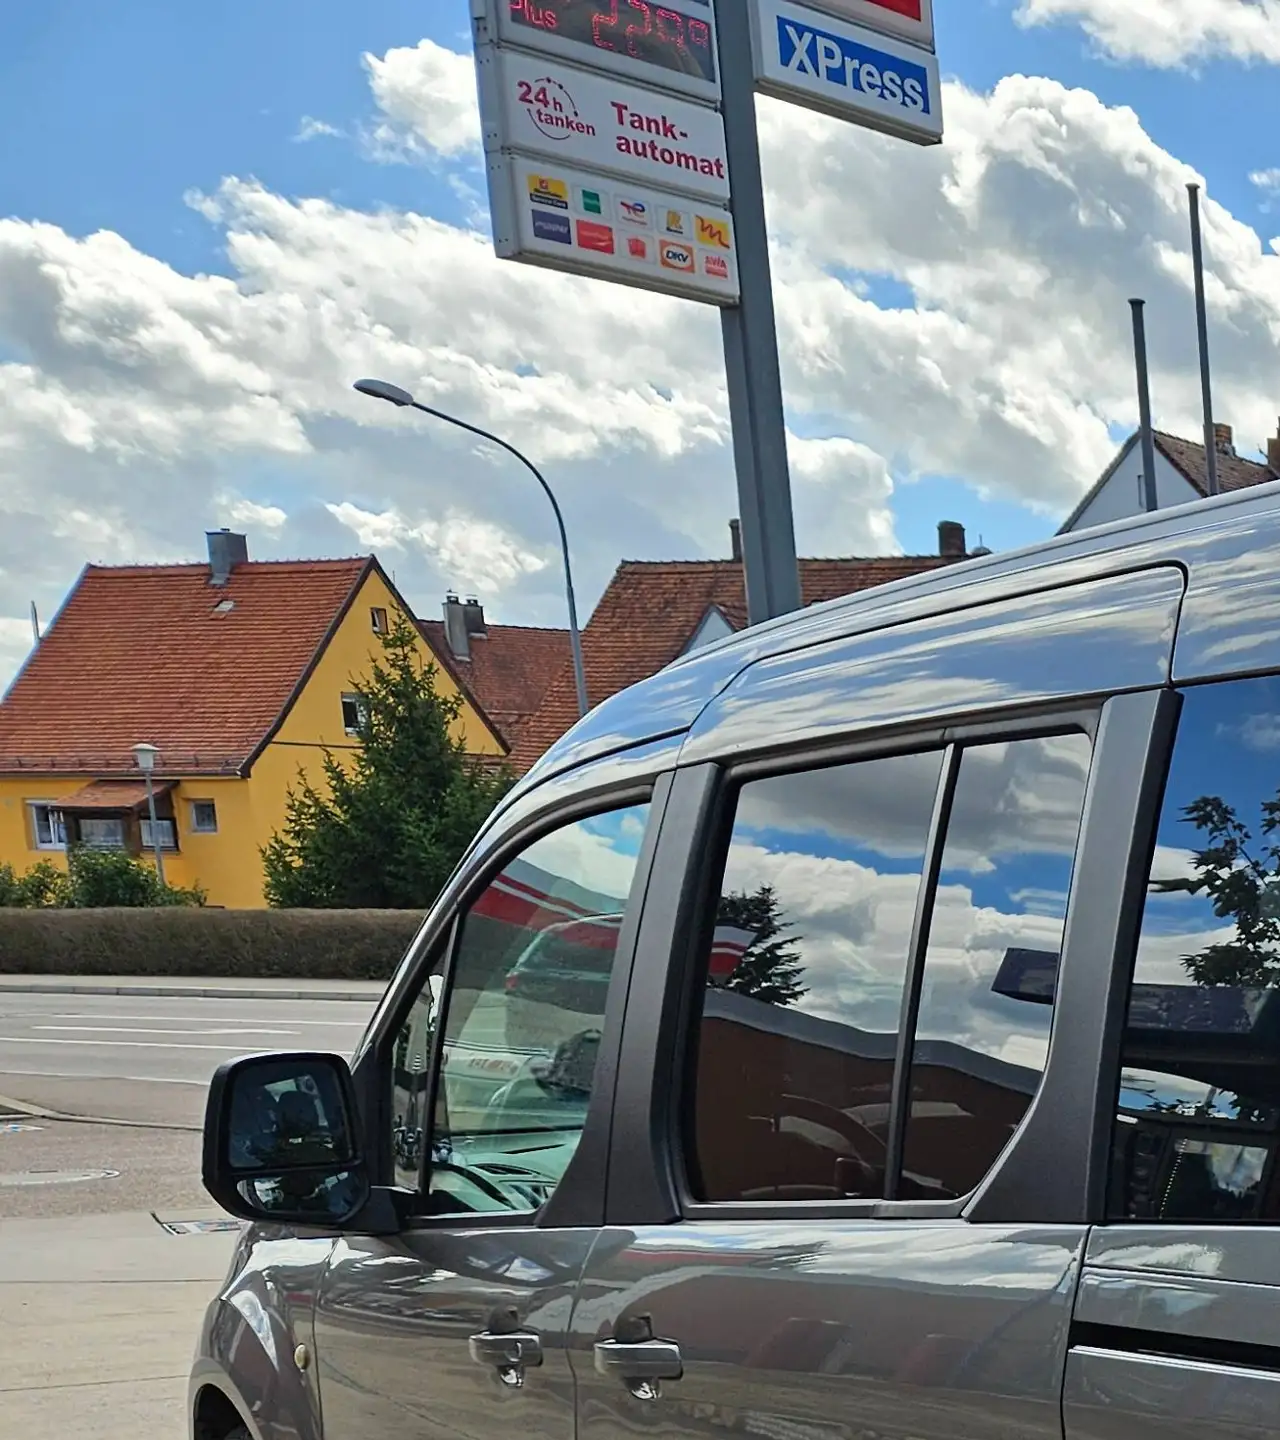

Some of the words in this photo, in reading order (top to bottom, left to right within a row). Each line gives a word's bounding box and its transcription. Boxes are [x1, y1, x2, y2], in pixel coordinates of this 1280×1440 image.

[786, 25, 924, 112] XPress
[536, 108, 596, 137] tanken
[610, 101, 688, 141] Tank-
[616, 135, 725, 180] automat
[666, 250, 689, 263] DKV
